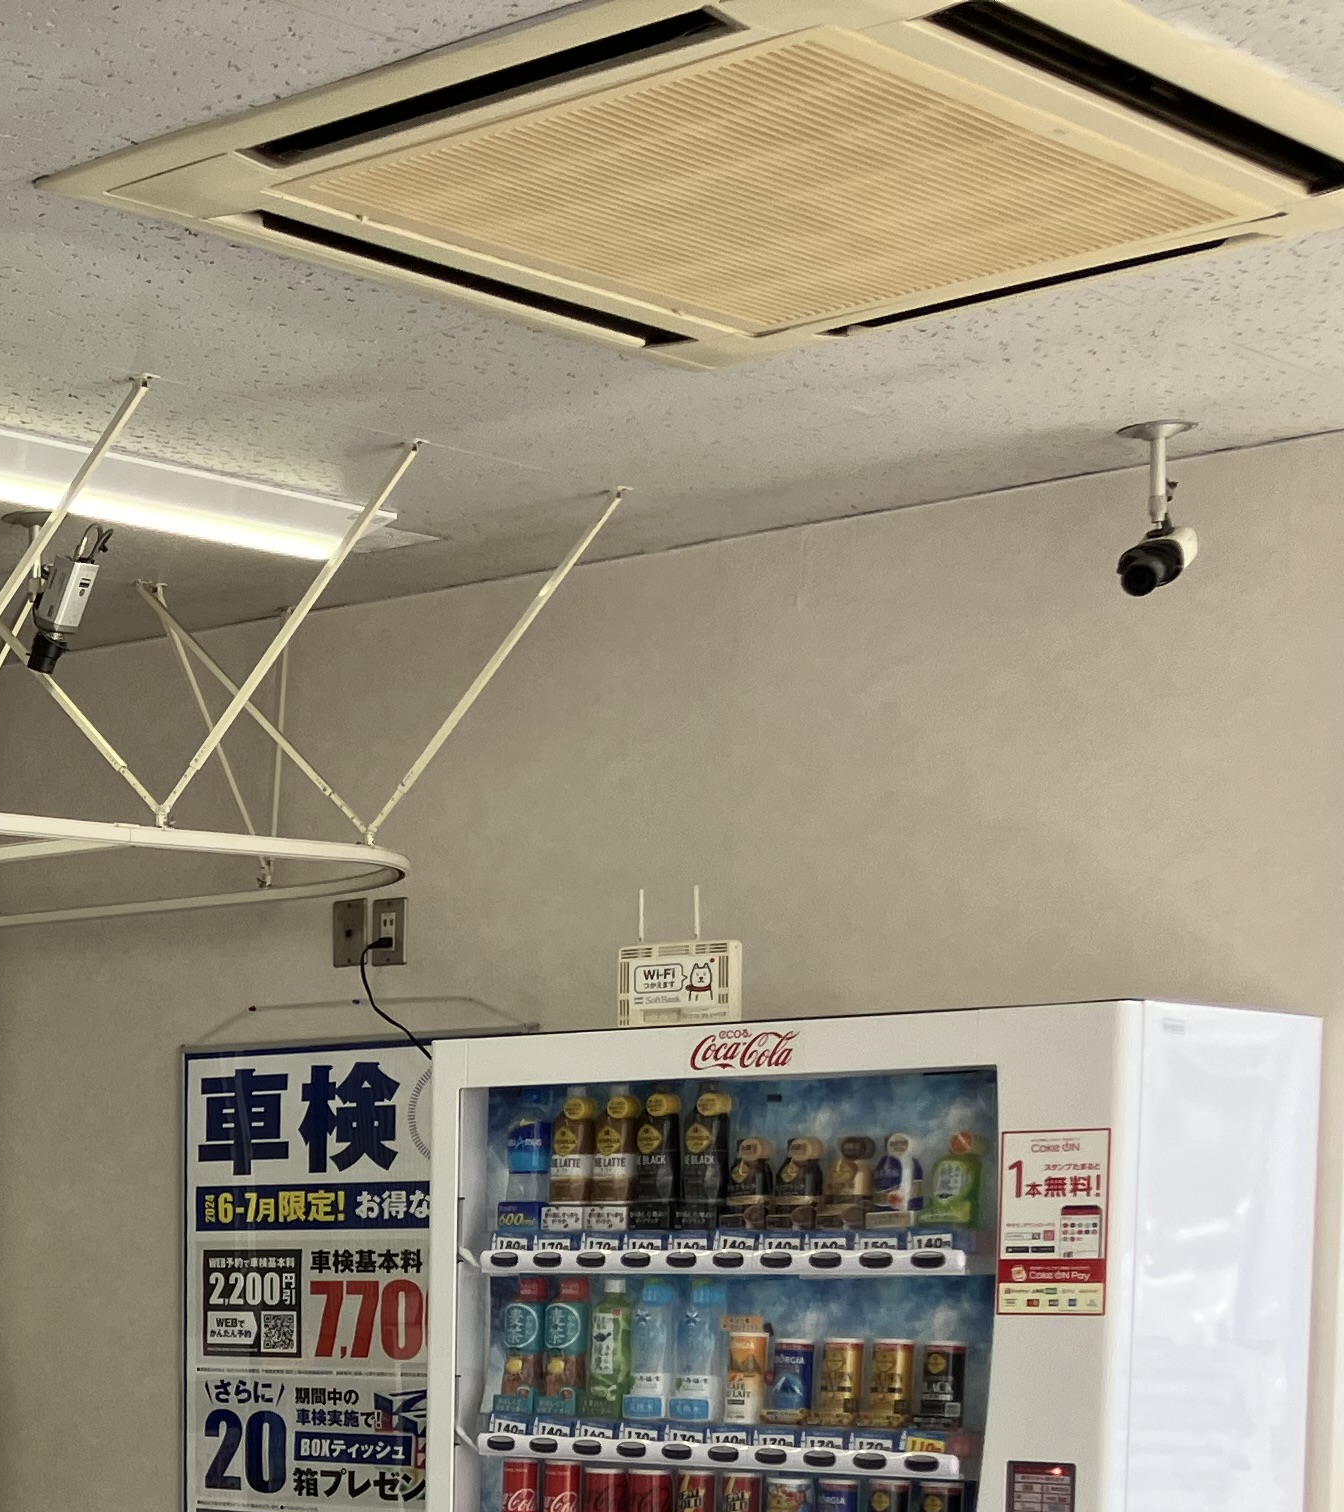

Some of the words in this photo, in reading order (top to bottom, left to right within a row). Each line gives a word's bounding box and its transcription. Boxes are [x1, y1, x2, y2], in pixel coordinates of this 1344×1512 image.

[642, 981, 675, 990] つかえます
[645, 995, 682, 1005] SoftBank
[690, 1030, 800, 1071] Coca-Cola
[198, 1061, 401, 1176] 車検
[1007, 1159, 1102, 1199] 1本無料!
[217, 1190, 346, 1223] 6-7月限定!
[208, 1257, 296, 1270] WEB予約で車検基本料
[310, 1249, 423, 1274] 車検基本料
[215, 1316, 246, 1329] WEBで
[310, 1279, 430, 1361] 7,70
[209, 1328, 252, 1339] かんたん予約
[213, 1379, 274, 1405] さらに
[294, 1386, 359, 1406] 期間中の
[204, 1408, 287, 1494] 20
[299, 1438, 406, 1460] BOXティッシュ
